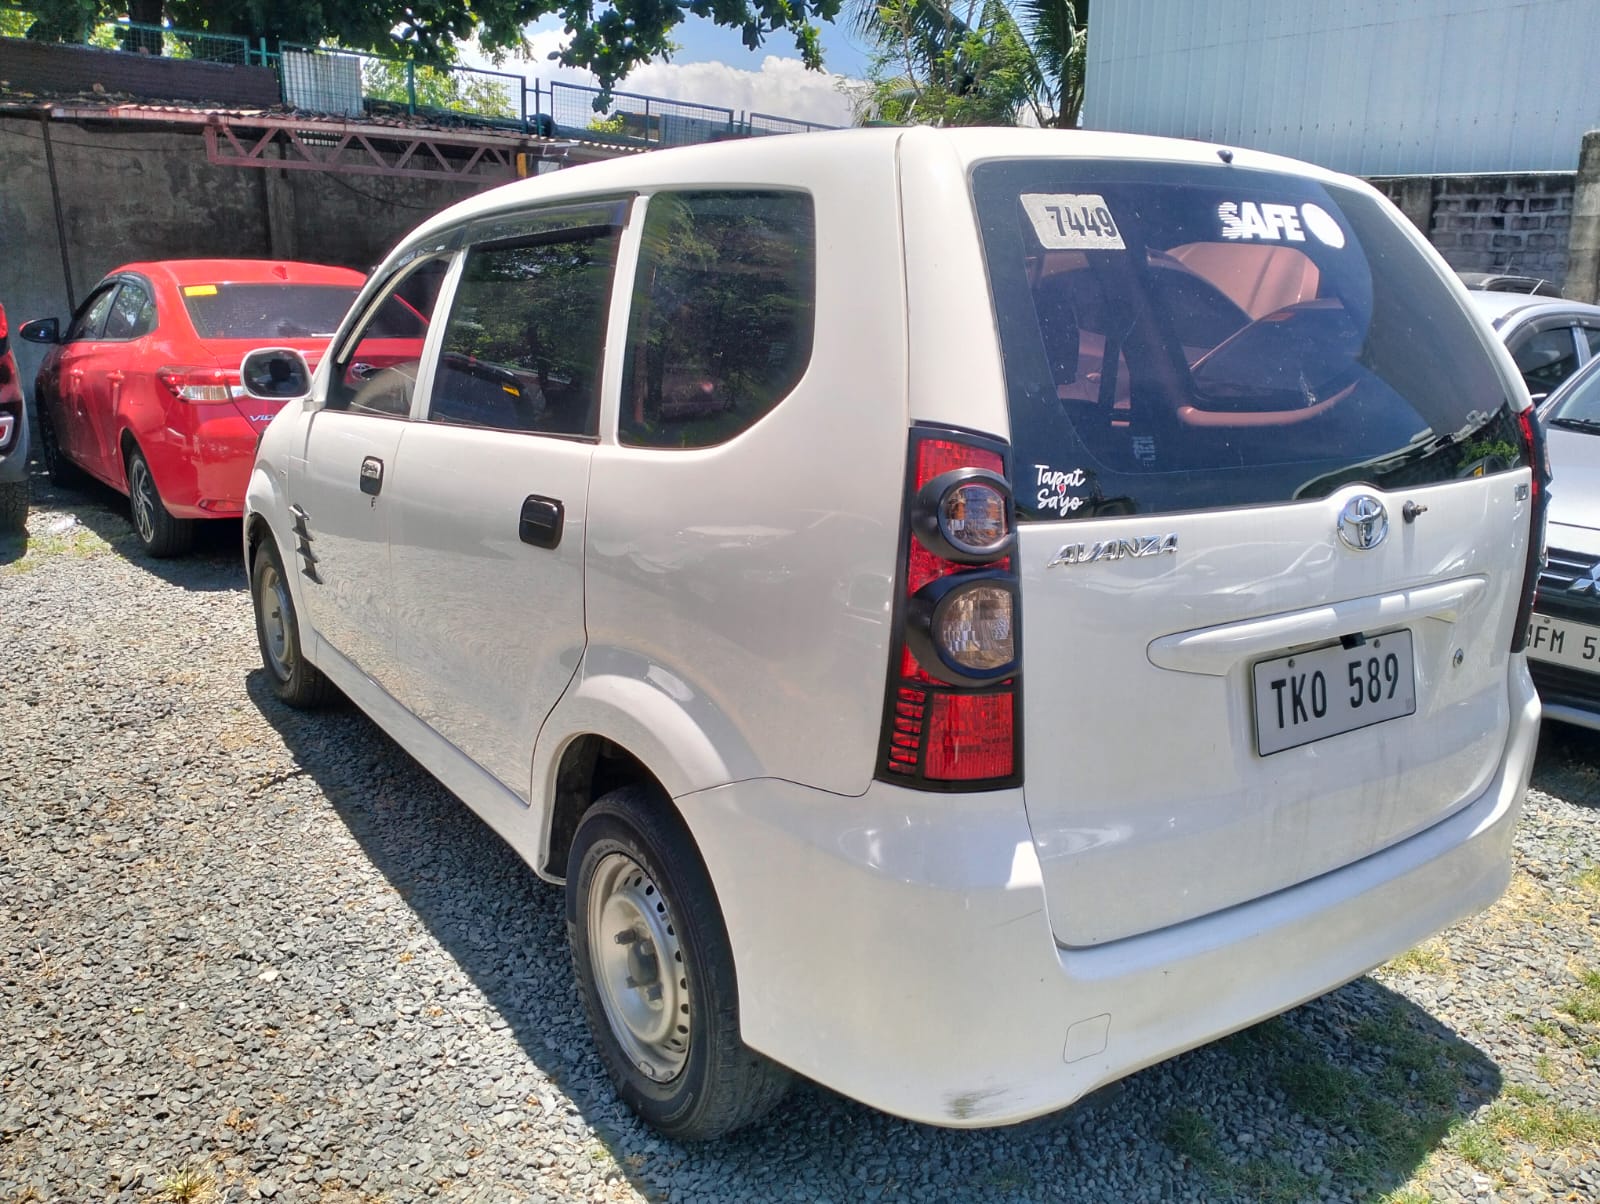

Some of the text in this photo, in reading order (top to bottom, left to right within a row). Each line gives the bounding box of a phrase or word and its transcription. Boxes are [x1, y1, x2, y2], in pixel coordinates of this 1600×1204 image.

[1045, 206, 1117, 238] 7449
[1218, 201, 1306, 241] SAFE
[1034, 464, 1086, 491] Tapat
[1037, 488, 1083, 517] Sayo
[1047, 532, 1178, 567] AVANZA
[1582, 635, 1600, 662] 5
[1271, 653, 1399, 729] TKO 589
